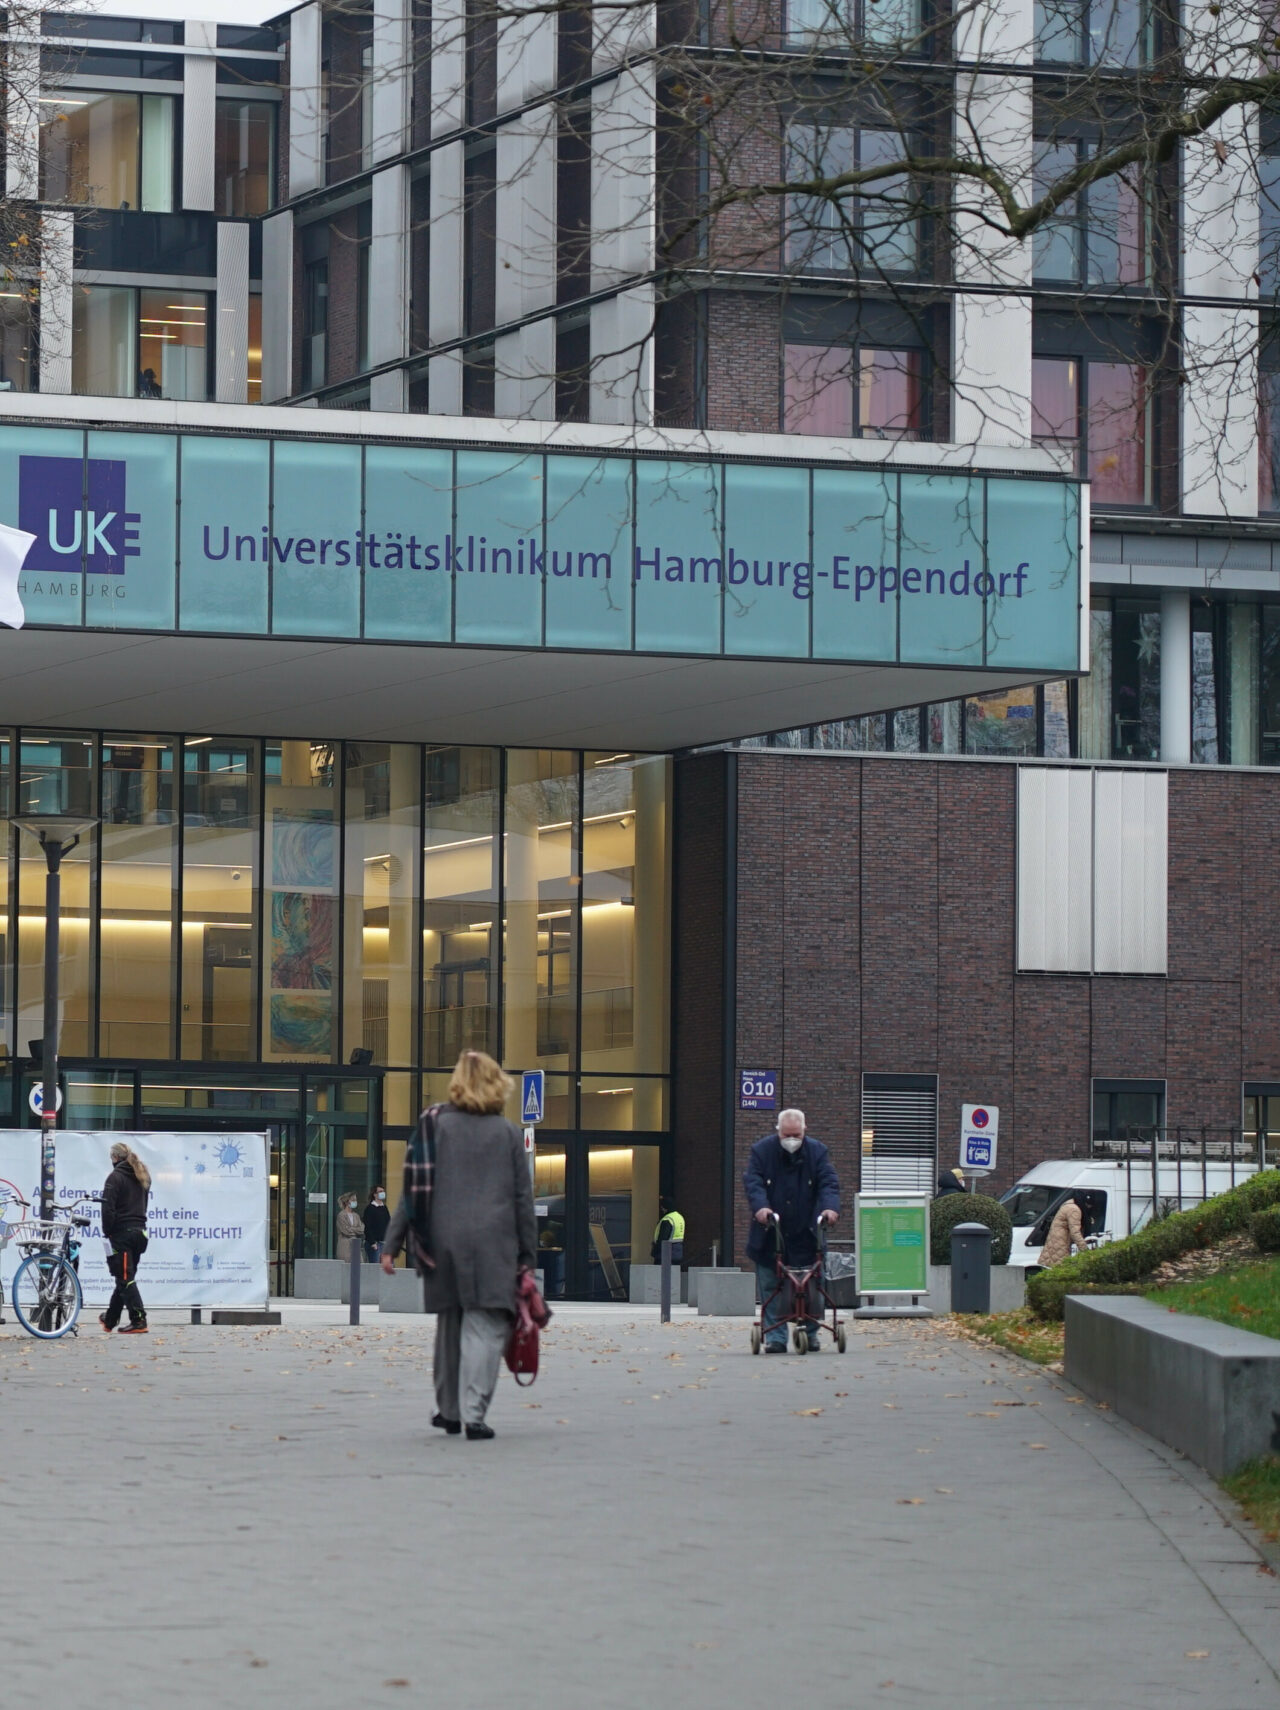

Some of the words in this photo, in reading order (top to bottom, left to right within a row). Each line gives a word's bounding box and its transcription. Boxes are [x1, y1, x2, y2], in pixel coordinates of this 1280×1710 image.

[48, 508, 141, 556] UKE
[202, 525, 612, 579] Universitätsklinikum
[635, 546, 1030, 603] Hamburg-Eppendorf
[17, 580, 126, 598] HAMBURG
[60, 1186, 87, 1199] dem
[148, 1207, 168, 1219] eht
[172, 1207, 199, 1219] eine
